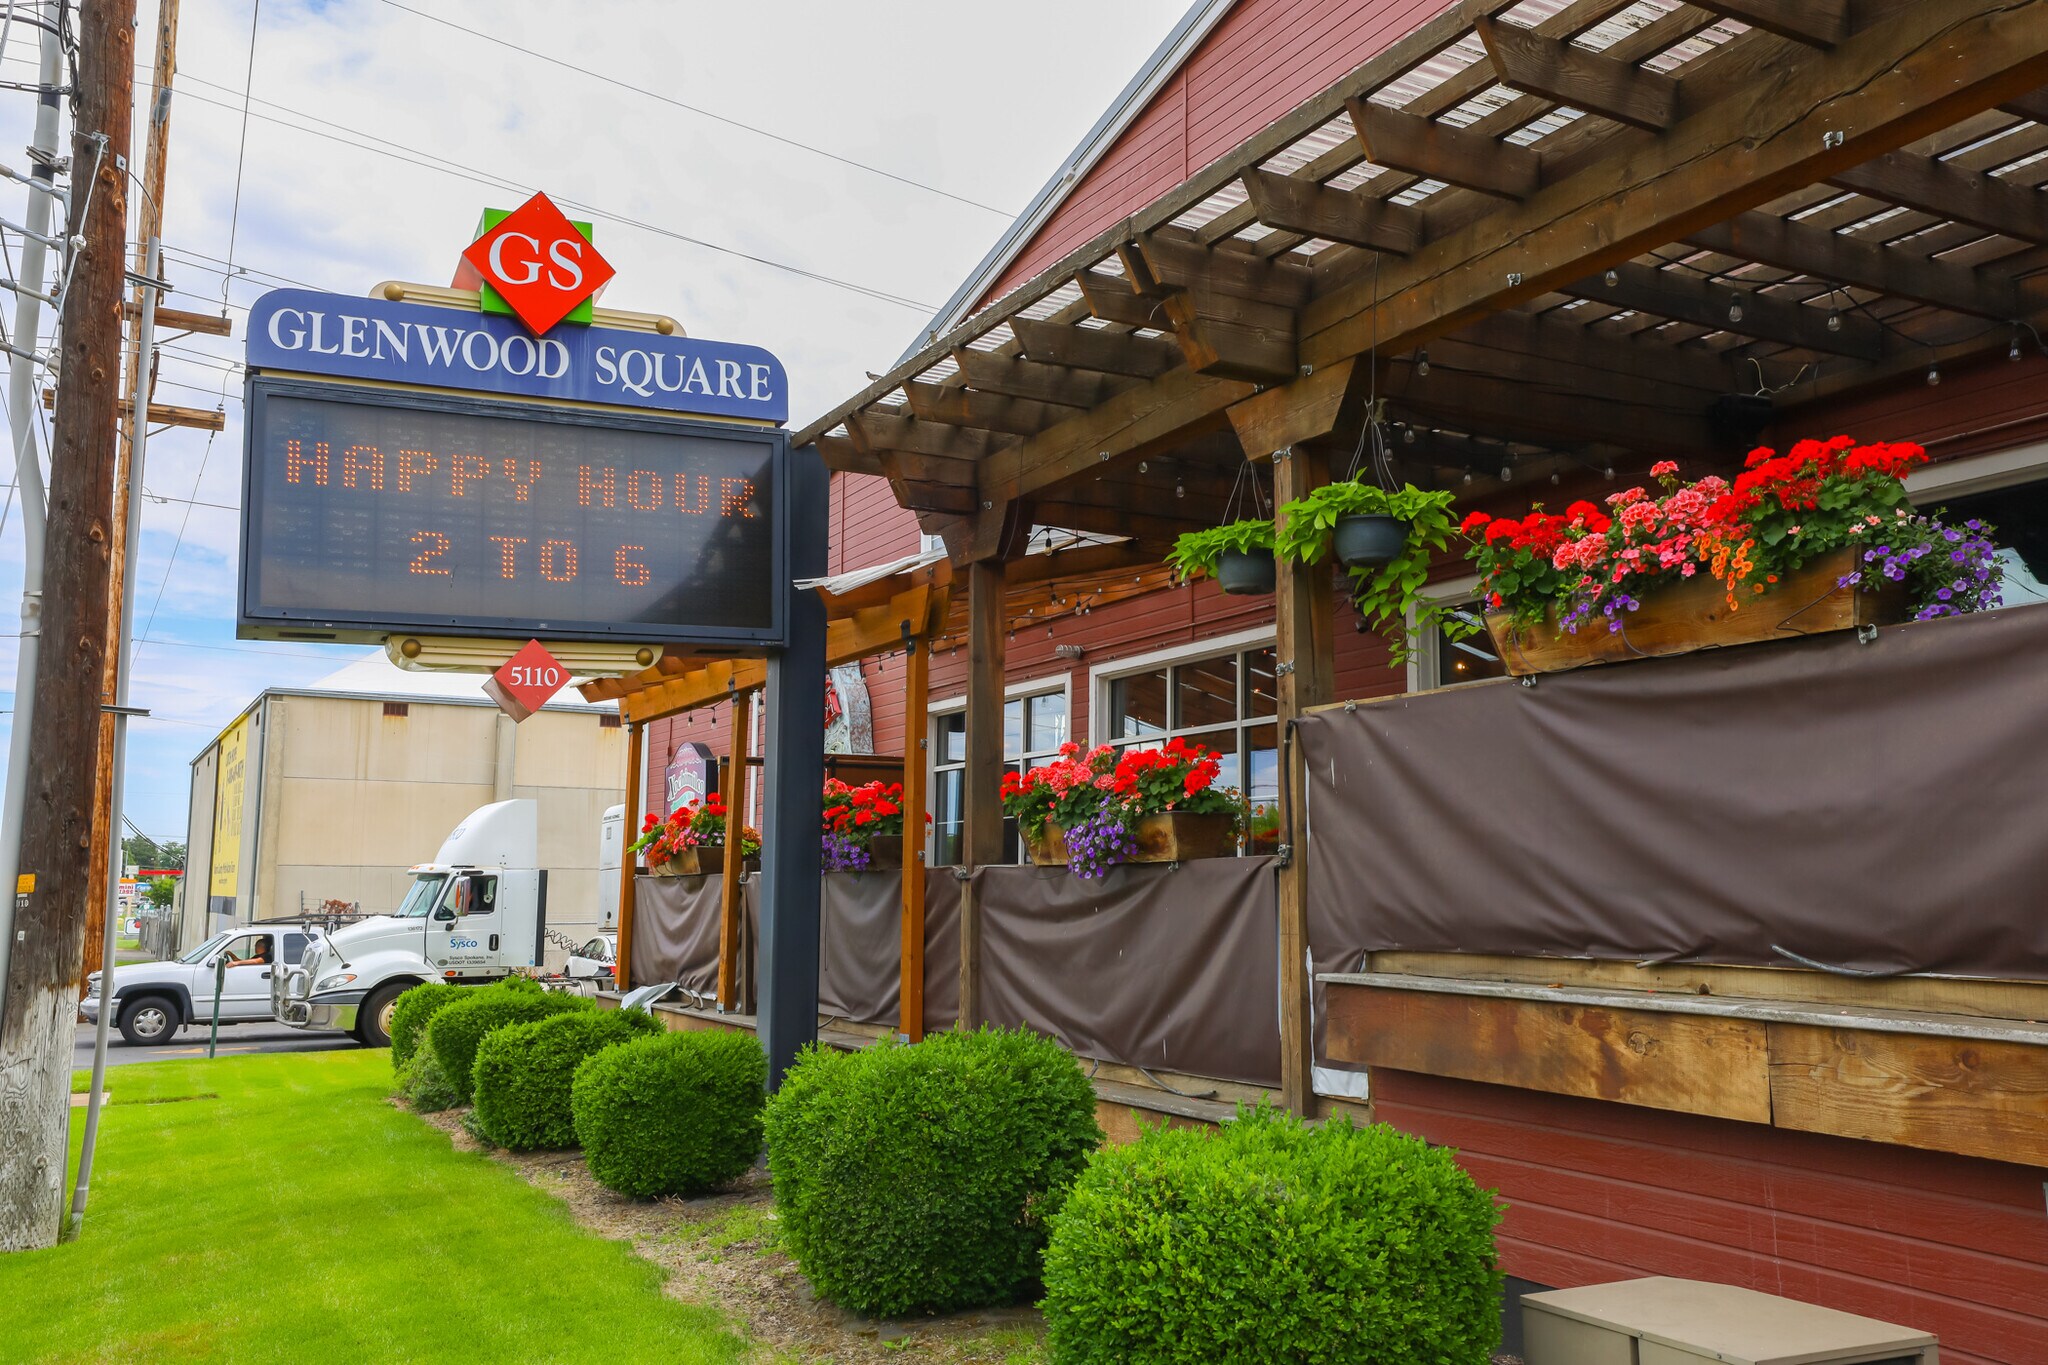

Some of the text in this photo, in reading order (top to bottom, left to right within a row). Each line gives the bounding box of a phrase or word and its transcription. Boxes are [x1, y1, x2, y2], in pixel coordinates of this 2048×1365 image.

[489, 232, 583, 291] GS
[268, 308, 773, 402] GLENWOOD SQUARE
[287, 439, 756, 519] HAPPY HOUR
[409, 530, 651, 586] 2 TO 6
[509, 665, 559, 687] 5110
[450, 939, 478, 950] Sysco
